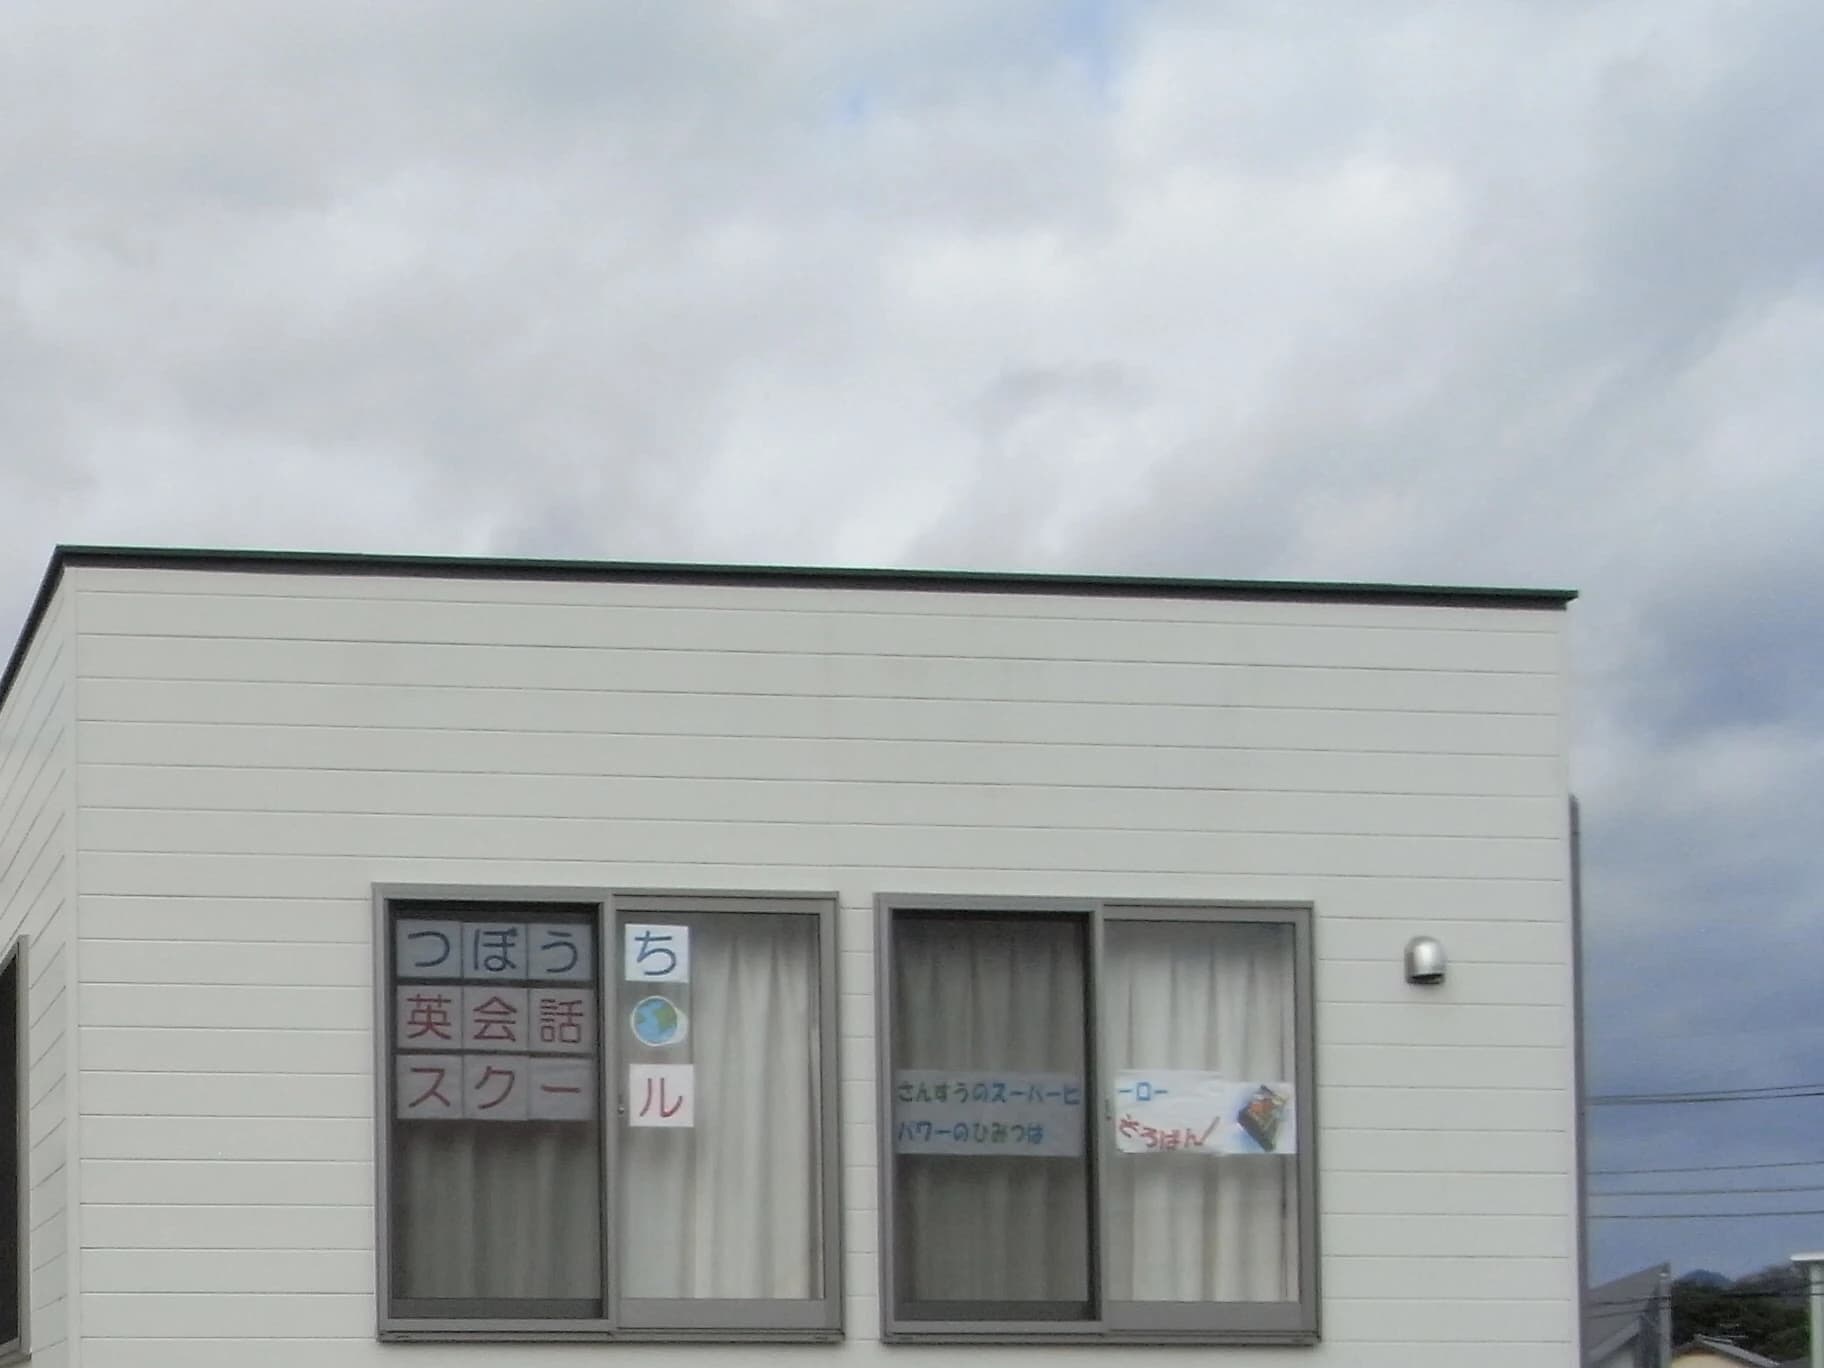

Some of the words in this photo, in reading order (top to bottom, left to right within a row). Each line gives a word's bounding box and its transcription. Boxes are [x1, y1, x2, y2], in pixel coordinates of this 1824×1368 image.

[407, 994, 584, 1044] 英会話
[408, 1065, 683, 1118] スクール
